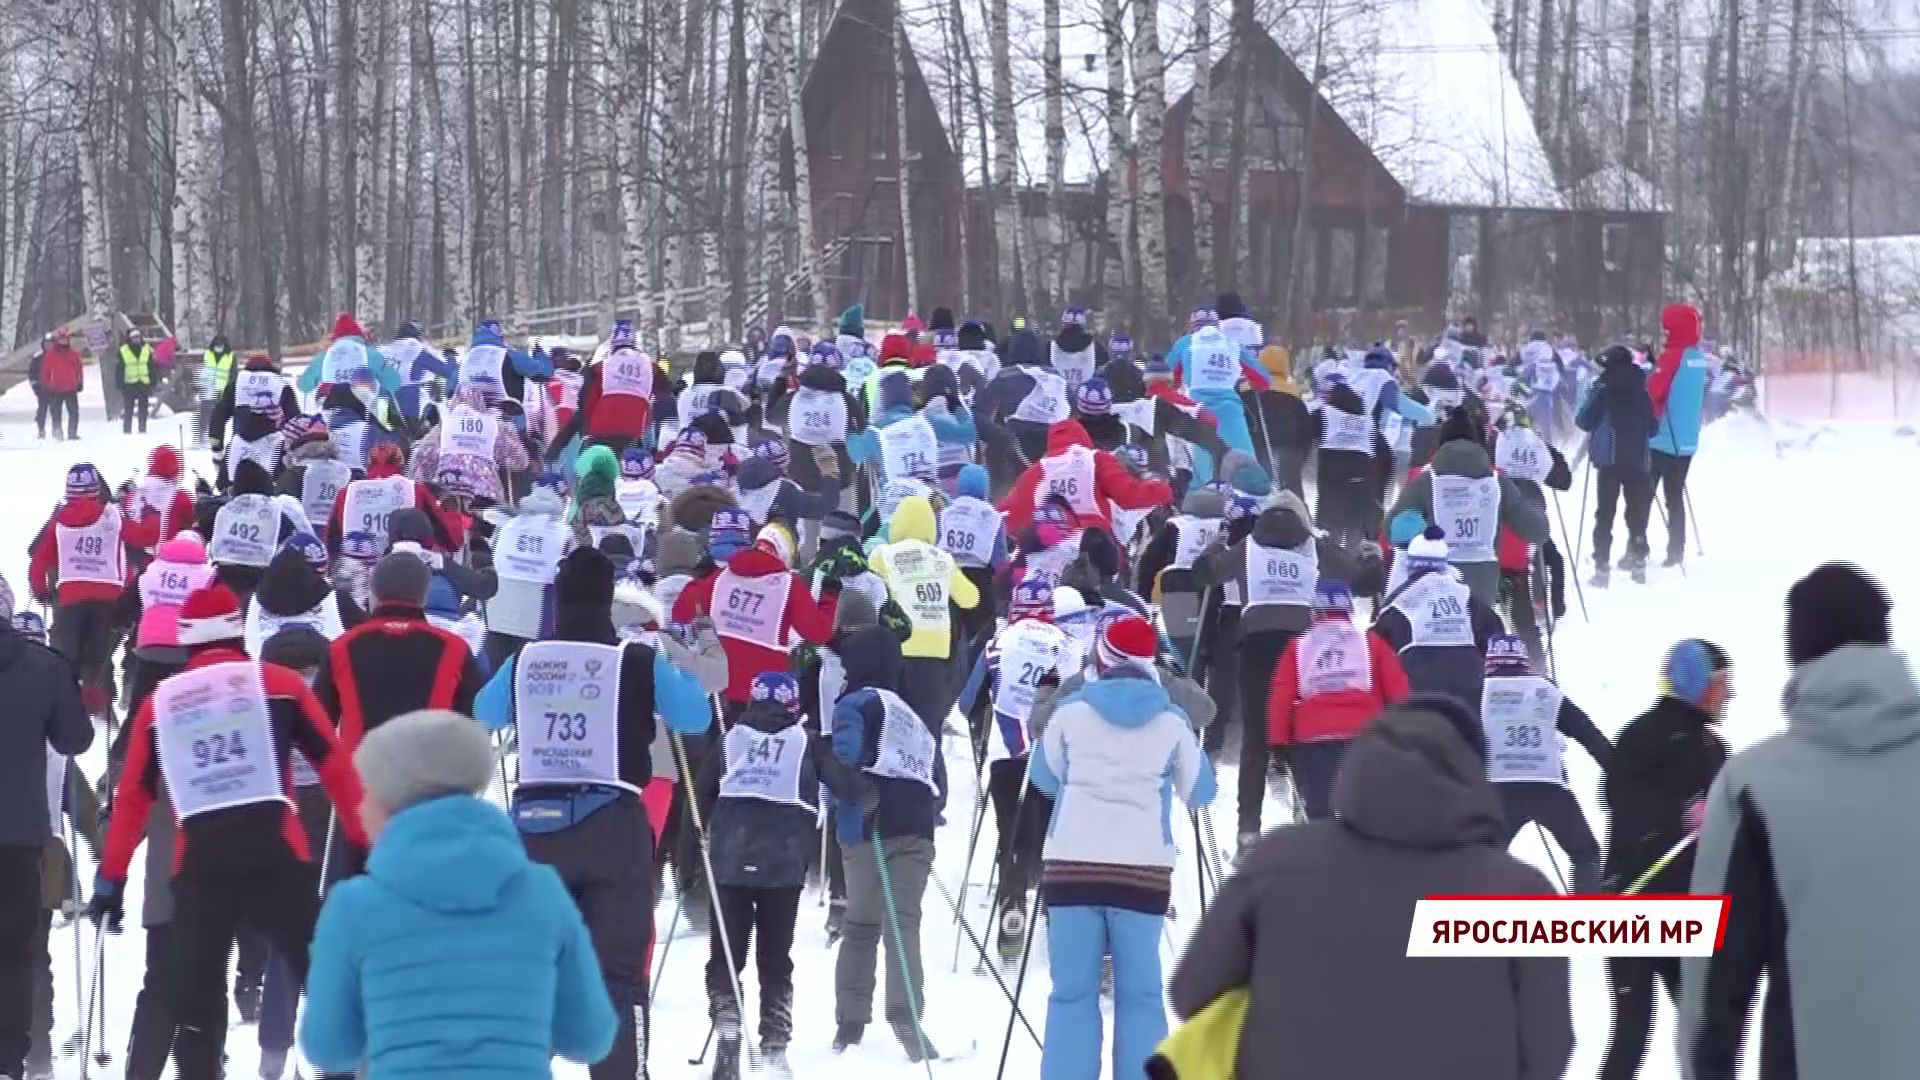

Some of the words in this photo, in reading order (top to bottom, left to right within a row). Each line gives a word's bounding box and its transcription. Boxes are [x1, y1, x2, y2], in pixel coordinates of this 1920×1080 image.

[460, 418, 484, 434] 180
[319, 482, 337, 499] 20
[228, 522, 261, 543] 492
[1454, 516, 1480, 538] 301
[74, 535, 104, 556] 498
[516, 533, 545, 555] 611
[946, 529, 976, 551] 638
[158, 570, 189, 591] 164
[1265, 560, 1300, 580] 660
[728, 587, 765, 615] 677
[1429, 595, 1462, 619] 208
[1017, 662, 1046, 689] 20
[543, 711, 588, 741] 733
[1503, 724, 1542, 749] 383
[192, 729, 246, 768] 924
